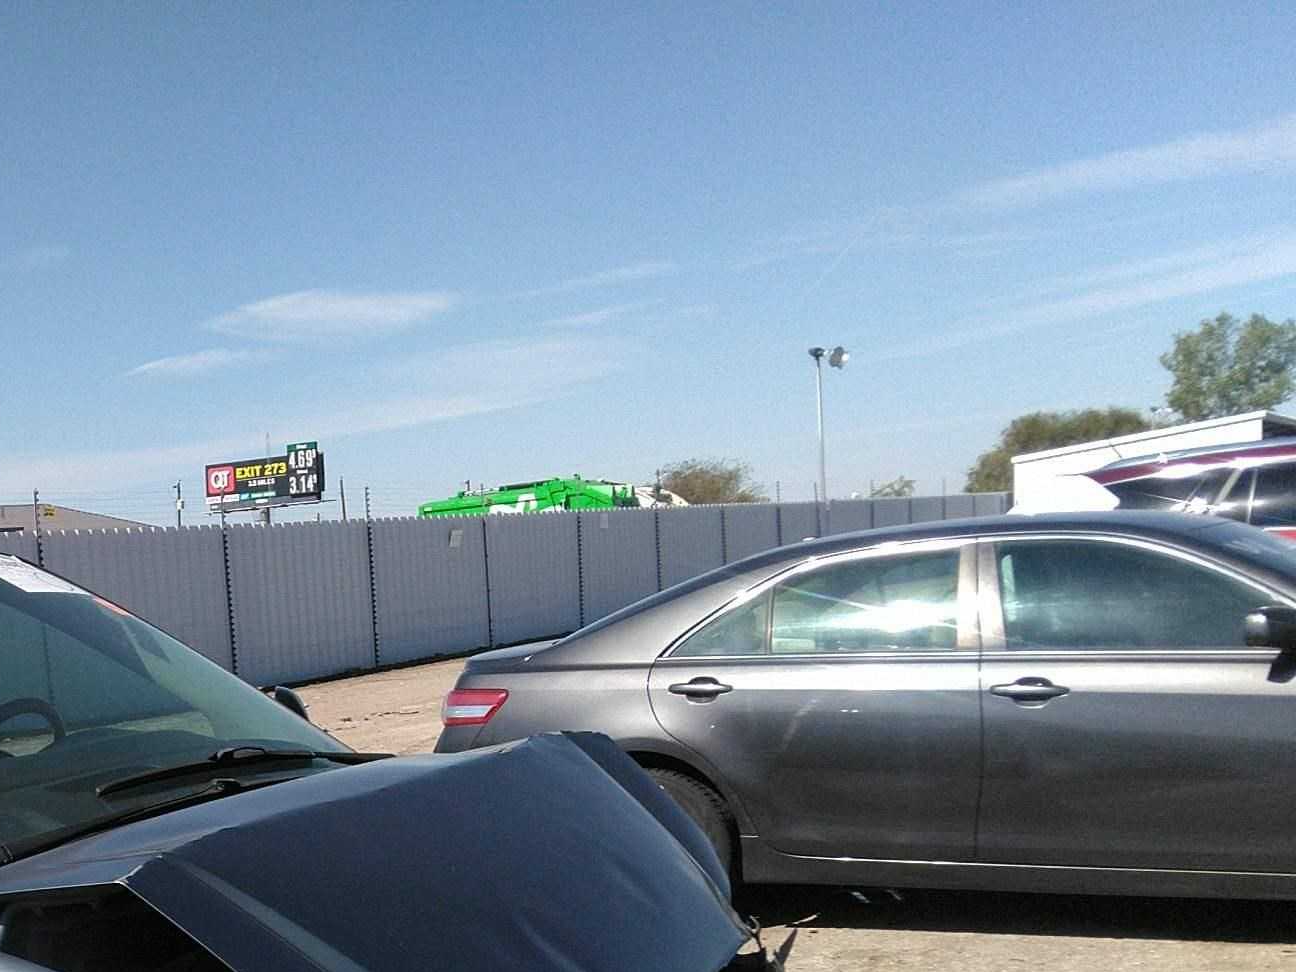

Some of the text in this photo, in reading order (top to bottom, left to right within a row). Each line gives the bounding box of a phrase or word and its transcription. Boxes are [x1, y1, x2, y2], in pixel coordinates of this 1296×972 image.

[210, 470, 229, 489] QT
[235, 465, 262, 479] EXIT
[264, 462, 287, 476] 273
